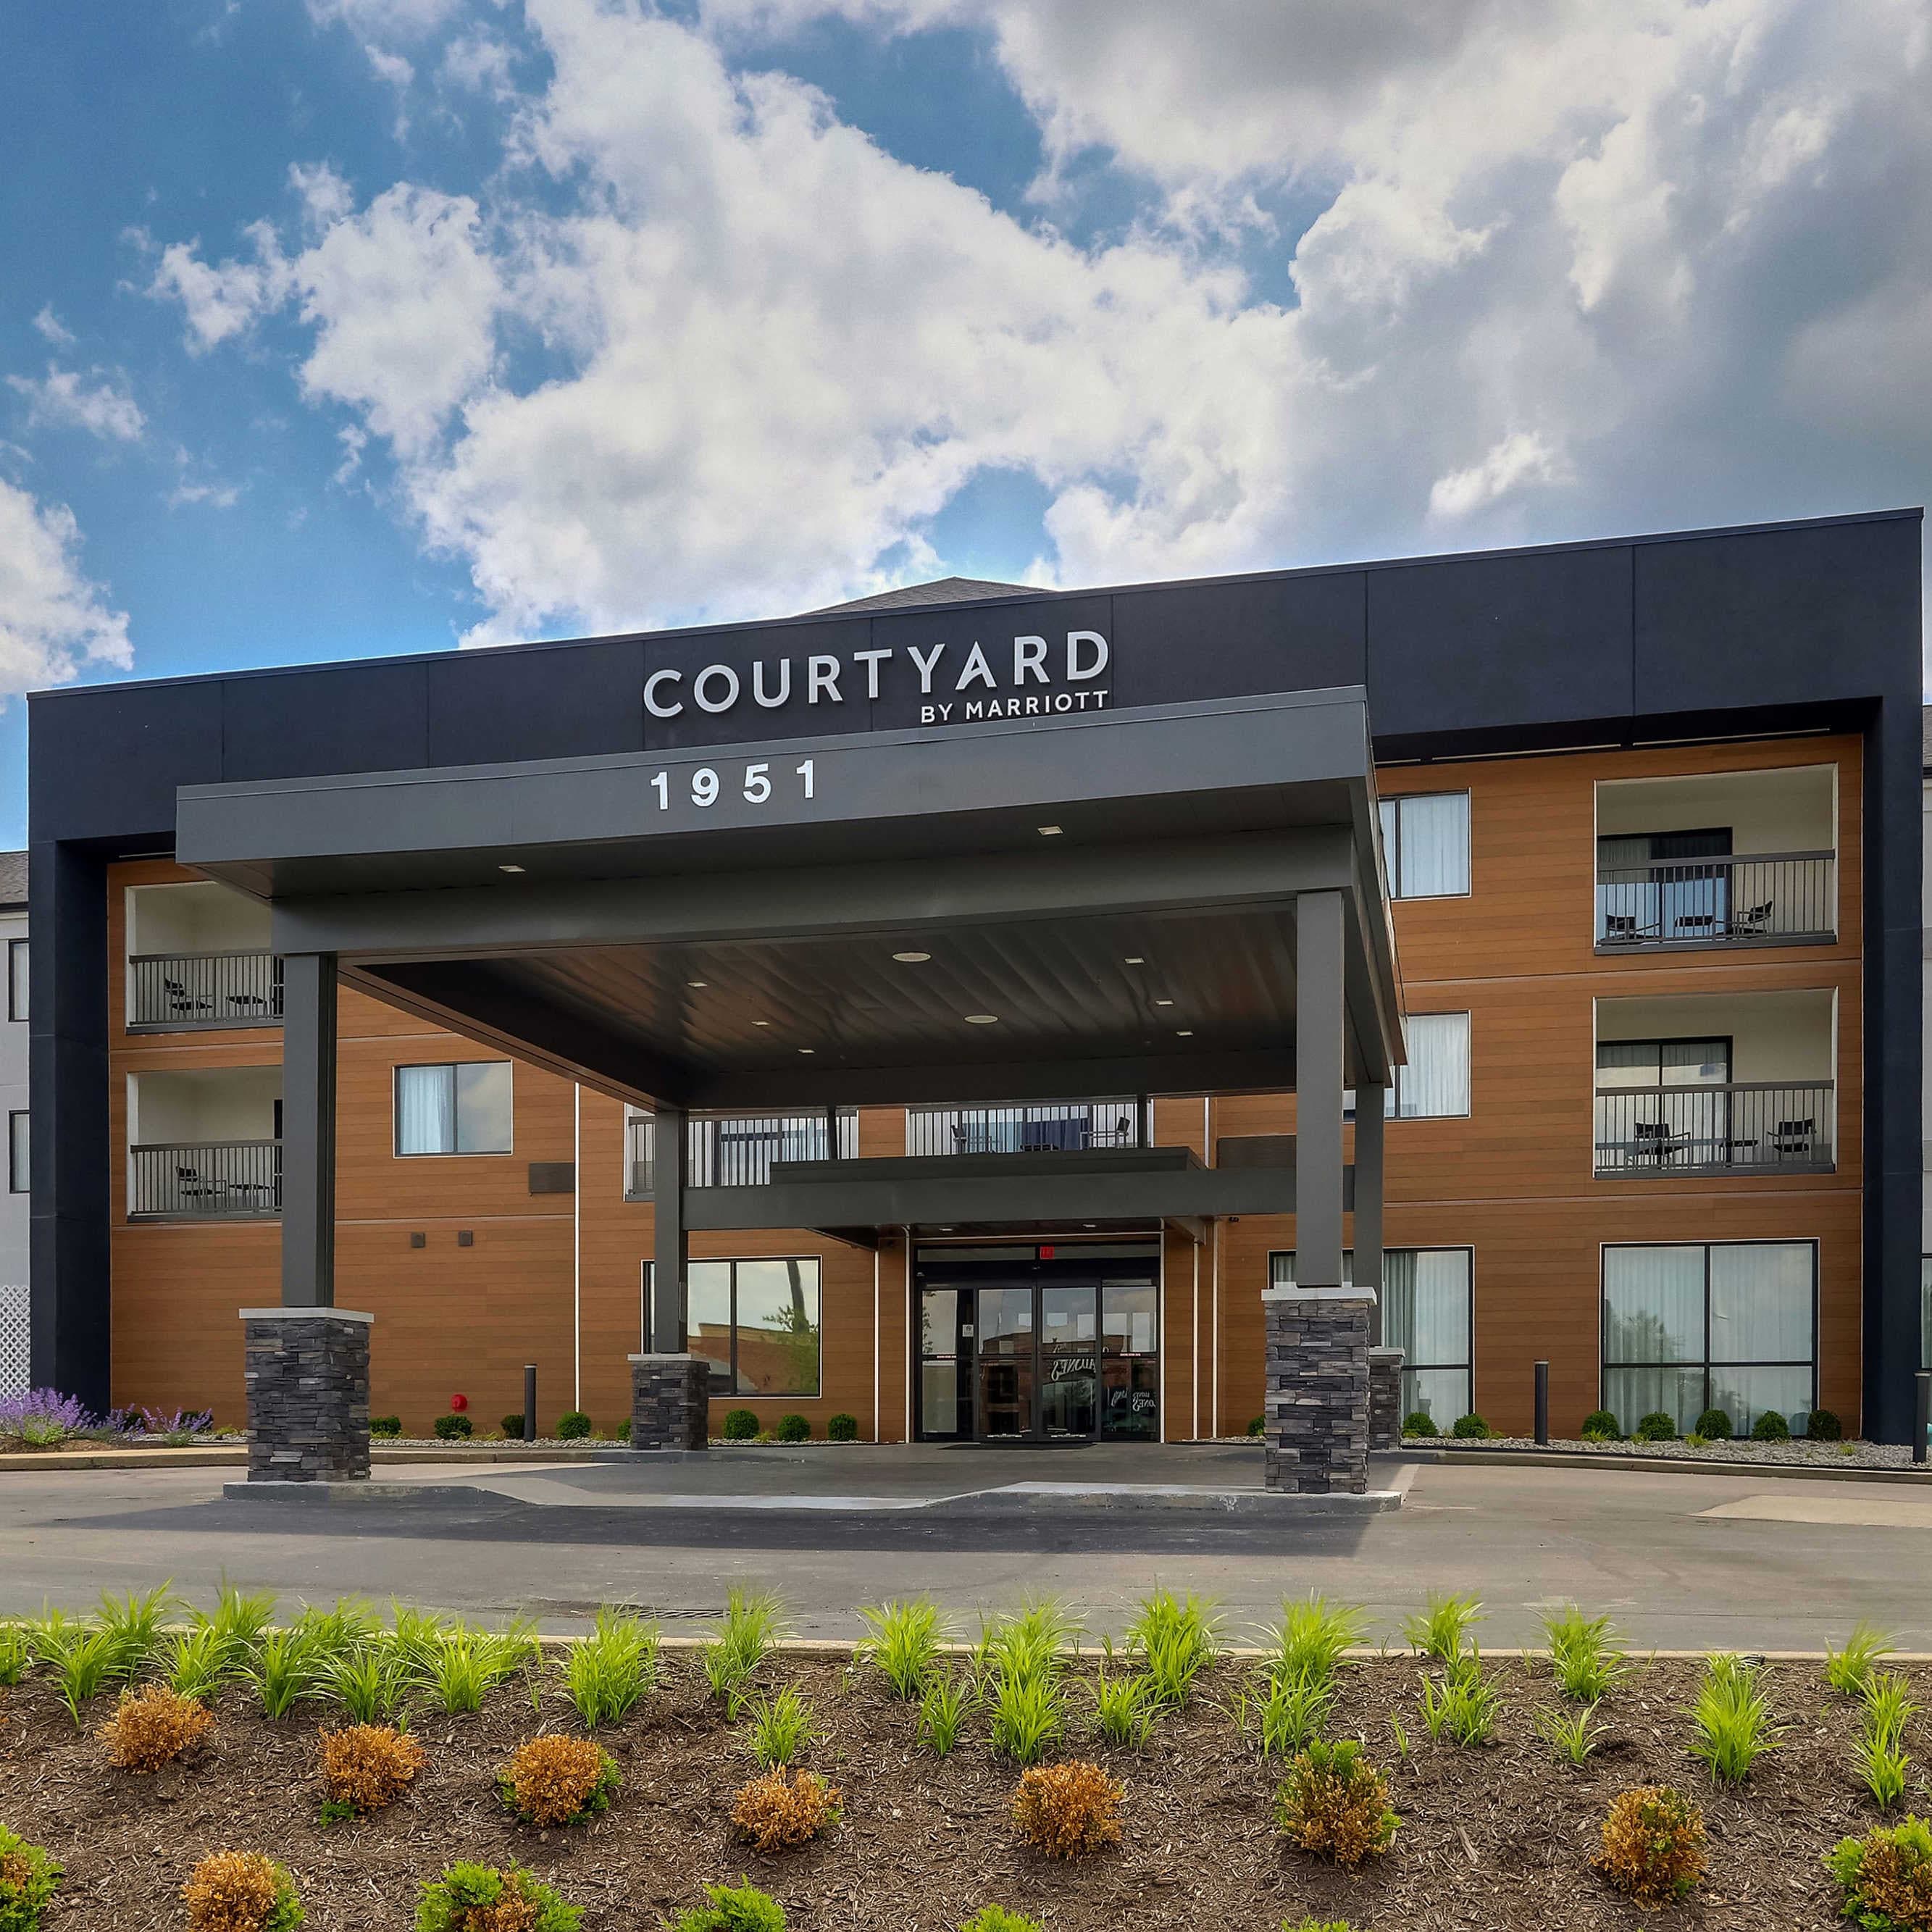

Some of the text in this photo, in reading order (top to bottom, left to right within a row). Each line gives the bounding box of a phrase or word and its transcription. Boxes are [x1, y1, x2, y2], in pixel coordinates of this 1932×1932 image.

[643, 630, 1108, 717] COURTYARD
[921, 690, 1108, 724] BY MARRIOTT
[651, 759, 814, 810] 1951
